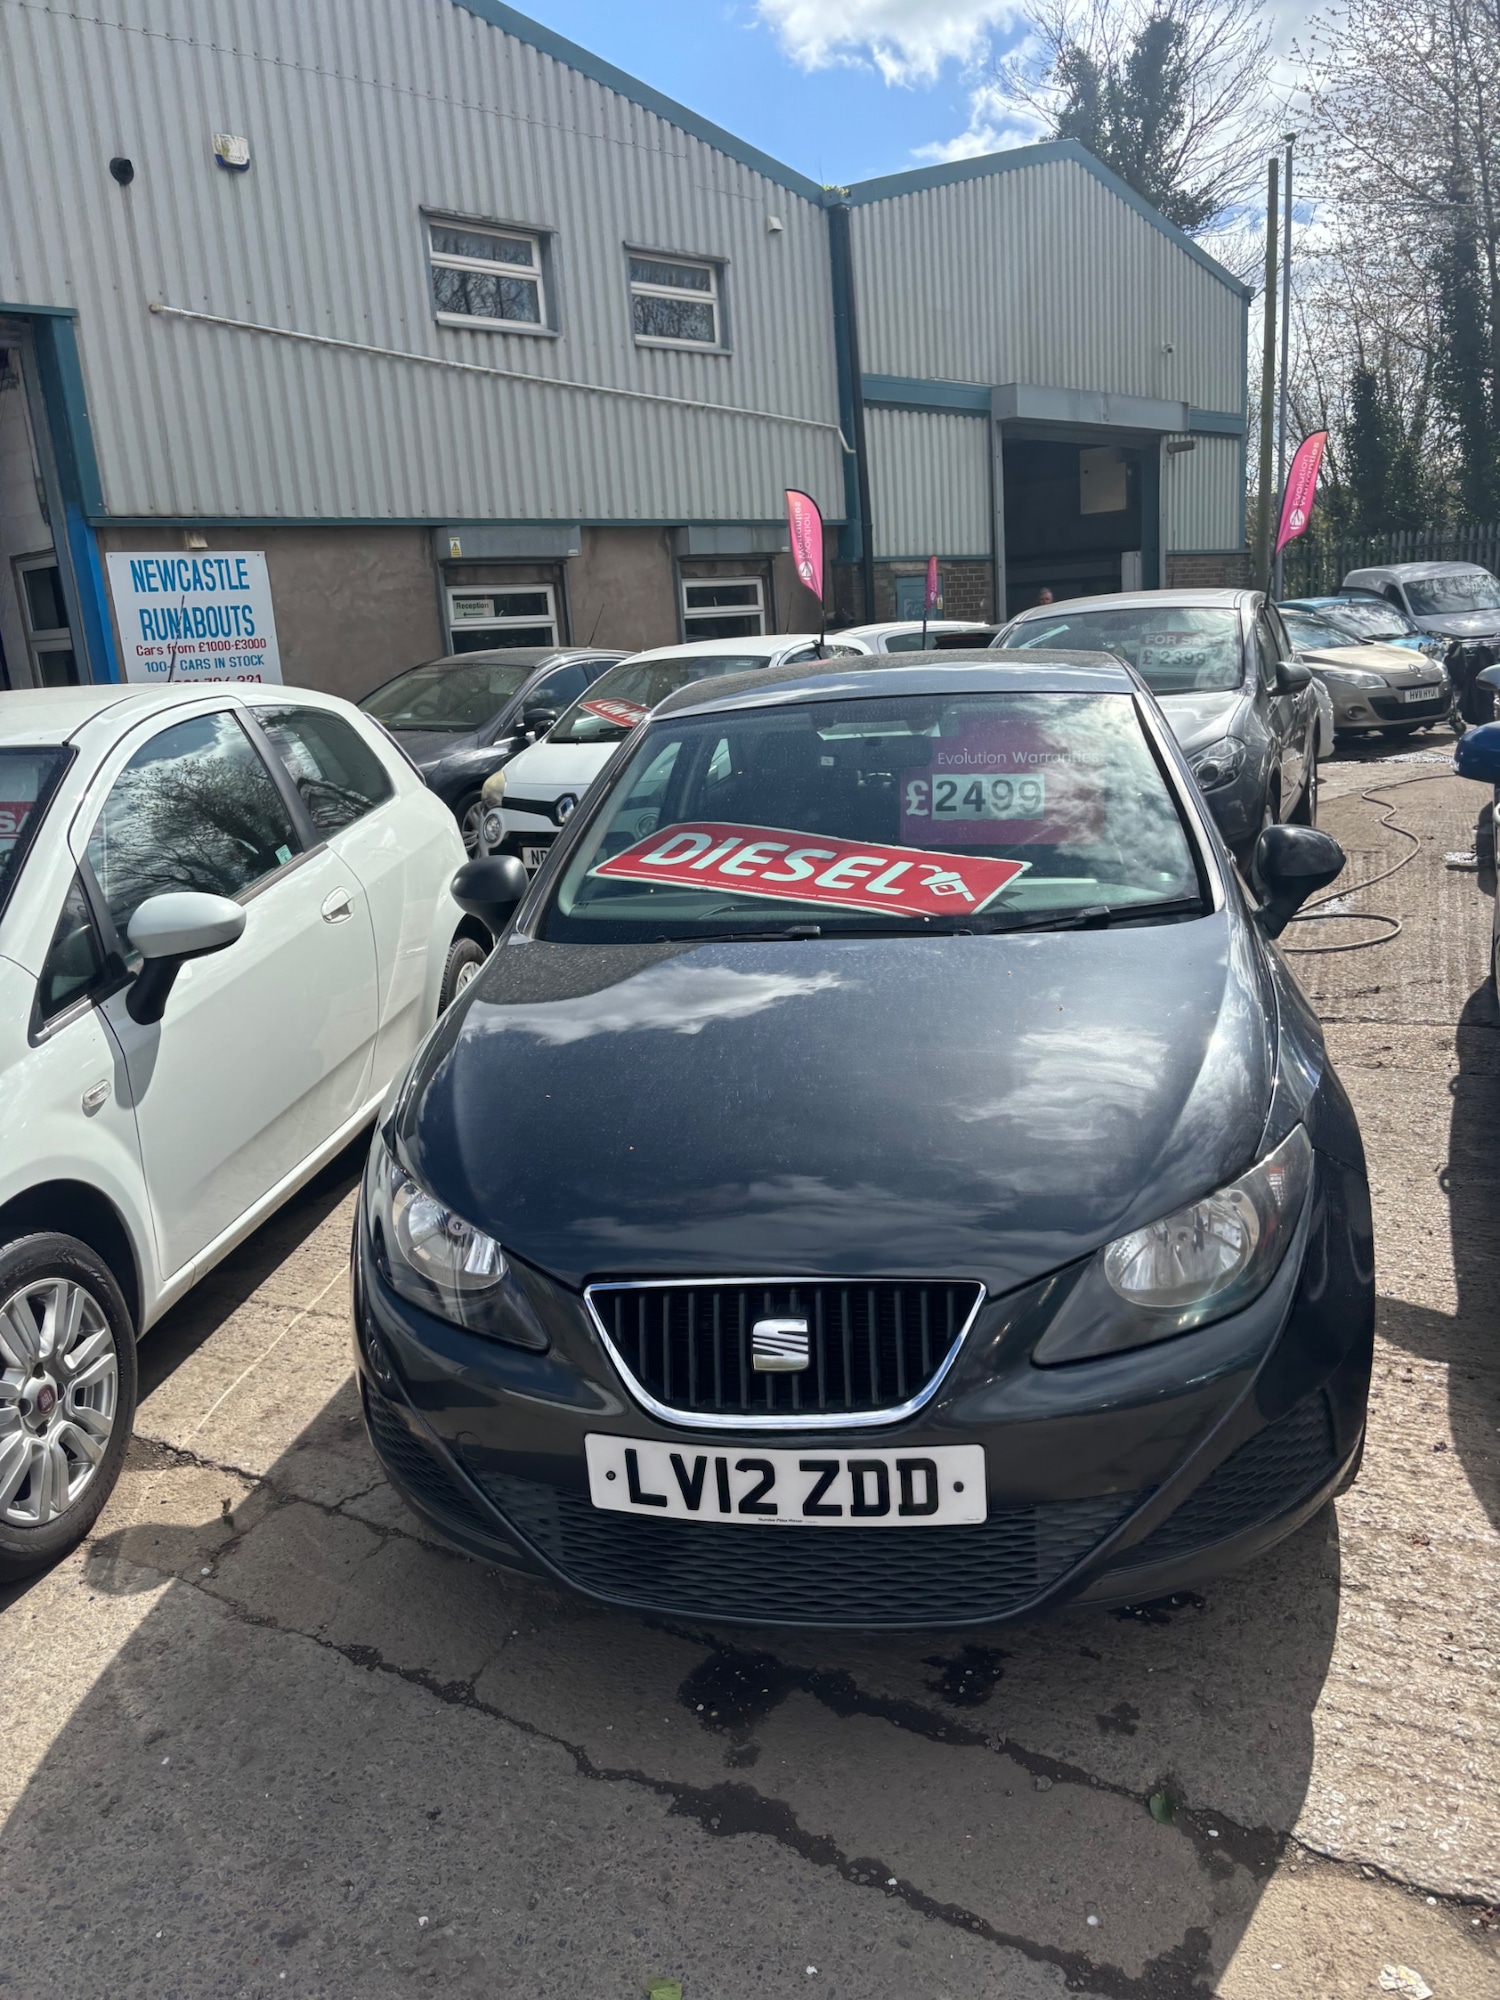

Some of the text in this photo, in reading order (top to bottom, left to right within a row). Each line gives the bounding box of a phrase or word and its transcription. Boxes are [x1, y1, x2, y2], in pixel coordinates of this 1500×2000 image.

[1293, 454, 1311, 506] Evolution
[1300, 442, 1320, 506] Warranties
[130, 558, 250, 593] NEWCASTLE
[139, 605, 255, 641] RUNABOUTS
[456, 602, 489, 610] Reception
[136, 638, 267, 656] Cars from £1000-£3000
[1145, 635, 1177, 645] FOR
[180, 658, 211, 671] CARS
[214, 657, 226, 669] IN
[229, 654, 265, 667] STOCK
[1160, 650, 1206, 666] 2399
[938, 751, 1099, 765] Evolution Warranties
[906, 780, 1042, 817] £2499
[639, 832, 915, 895] DIESEL
[625, 1449, 939, 1517] LV12 ZDD
